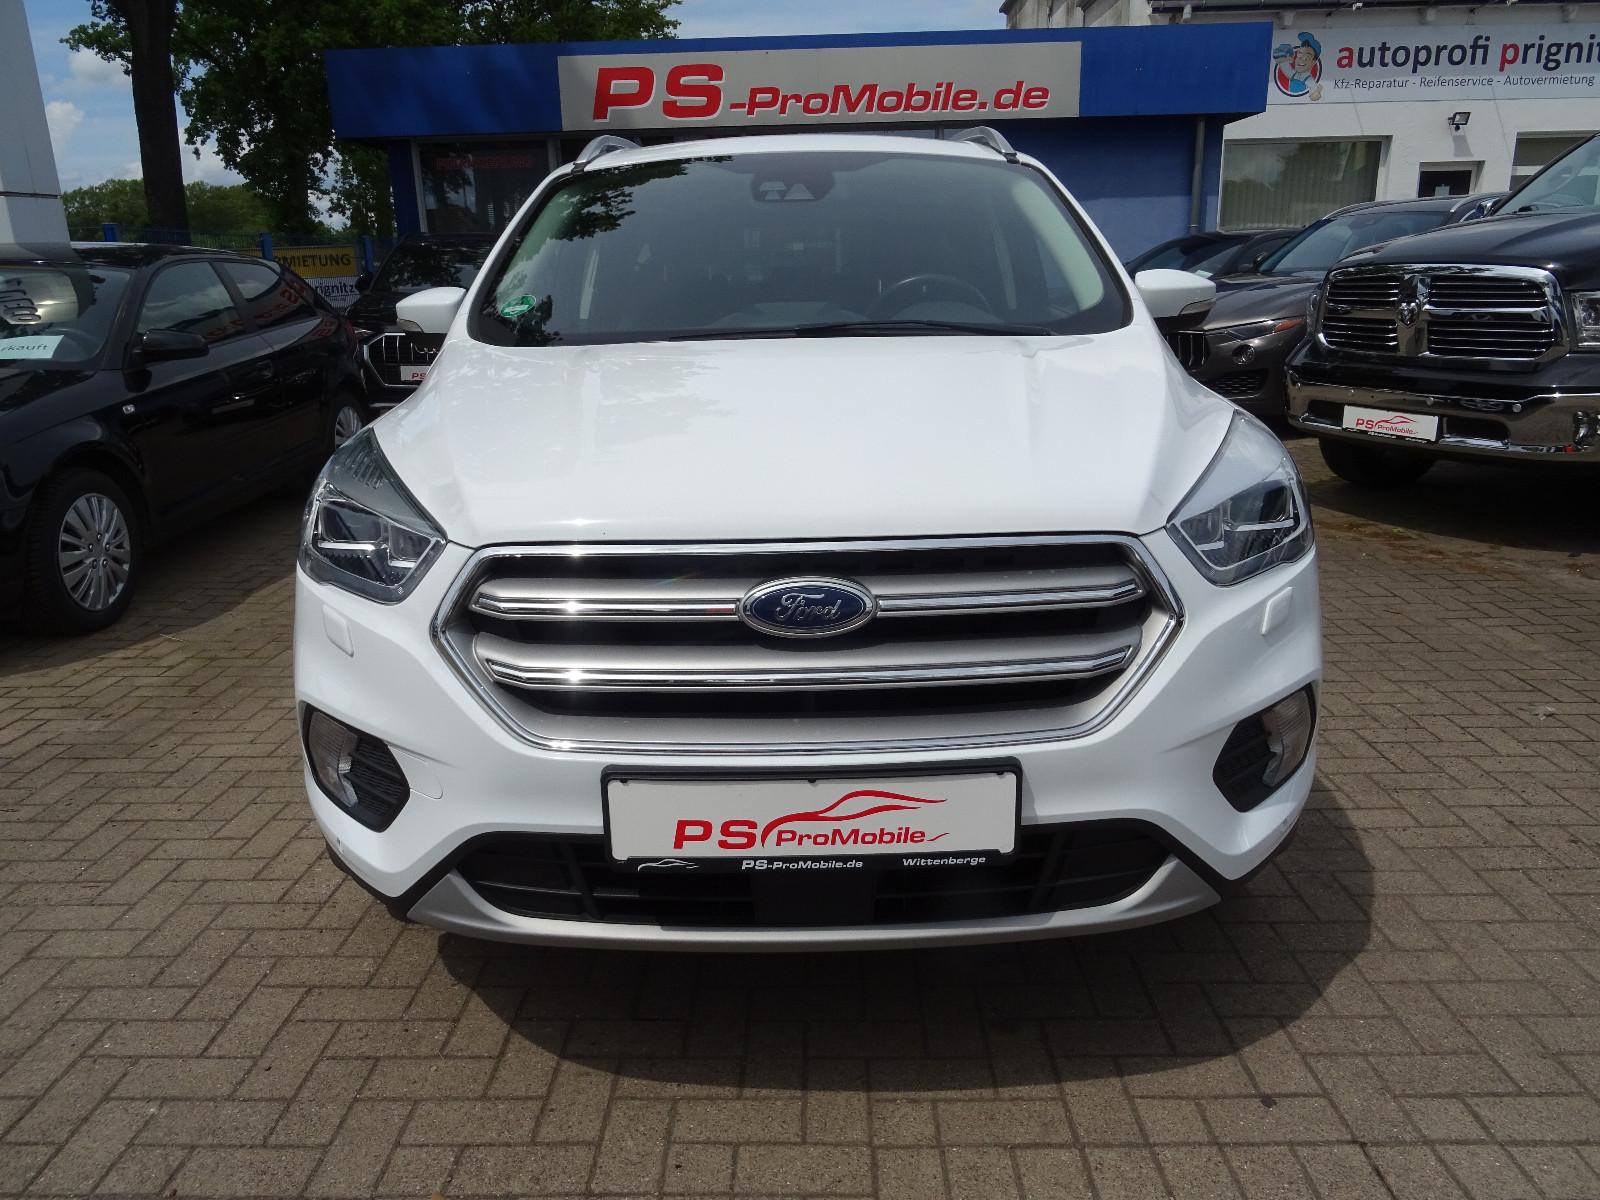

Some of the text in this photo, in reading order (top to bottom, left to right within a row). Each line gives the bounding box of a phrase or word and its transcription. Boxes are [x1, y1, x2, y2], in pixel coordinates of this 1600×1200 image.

[1336, 34, 1600, 74] autoprofi prigni
[592, 63, 1050, 121] PS-ProMobile.de
[1333, 78, 1410, 91] Kfz-Reparatur
[1419, 76, 1493, 88] Reifenservice
[1503, 74, 1595, 87] Autovermietung
[1355, 418, 1375, 430] PS
[776, 593, 842, 621] Ford
[673, 819, 926, 850] PS ProMobile
[741, 856, 987, 870] PS-ProMobile.de Wittenberge
